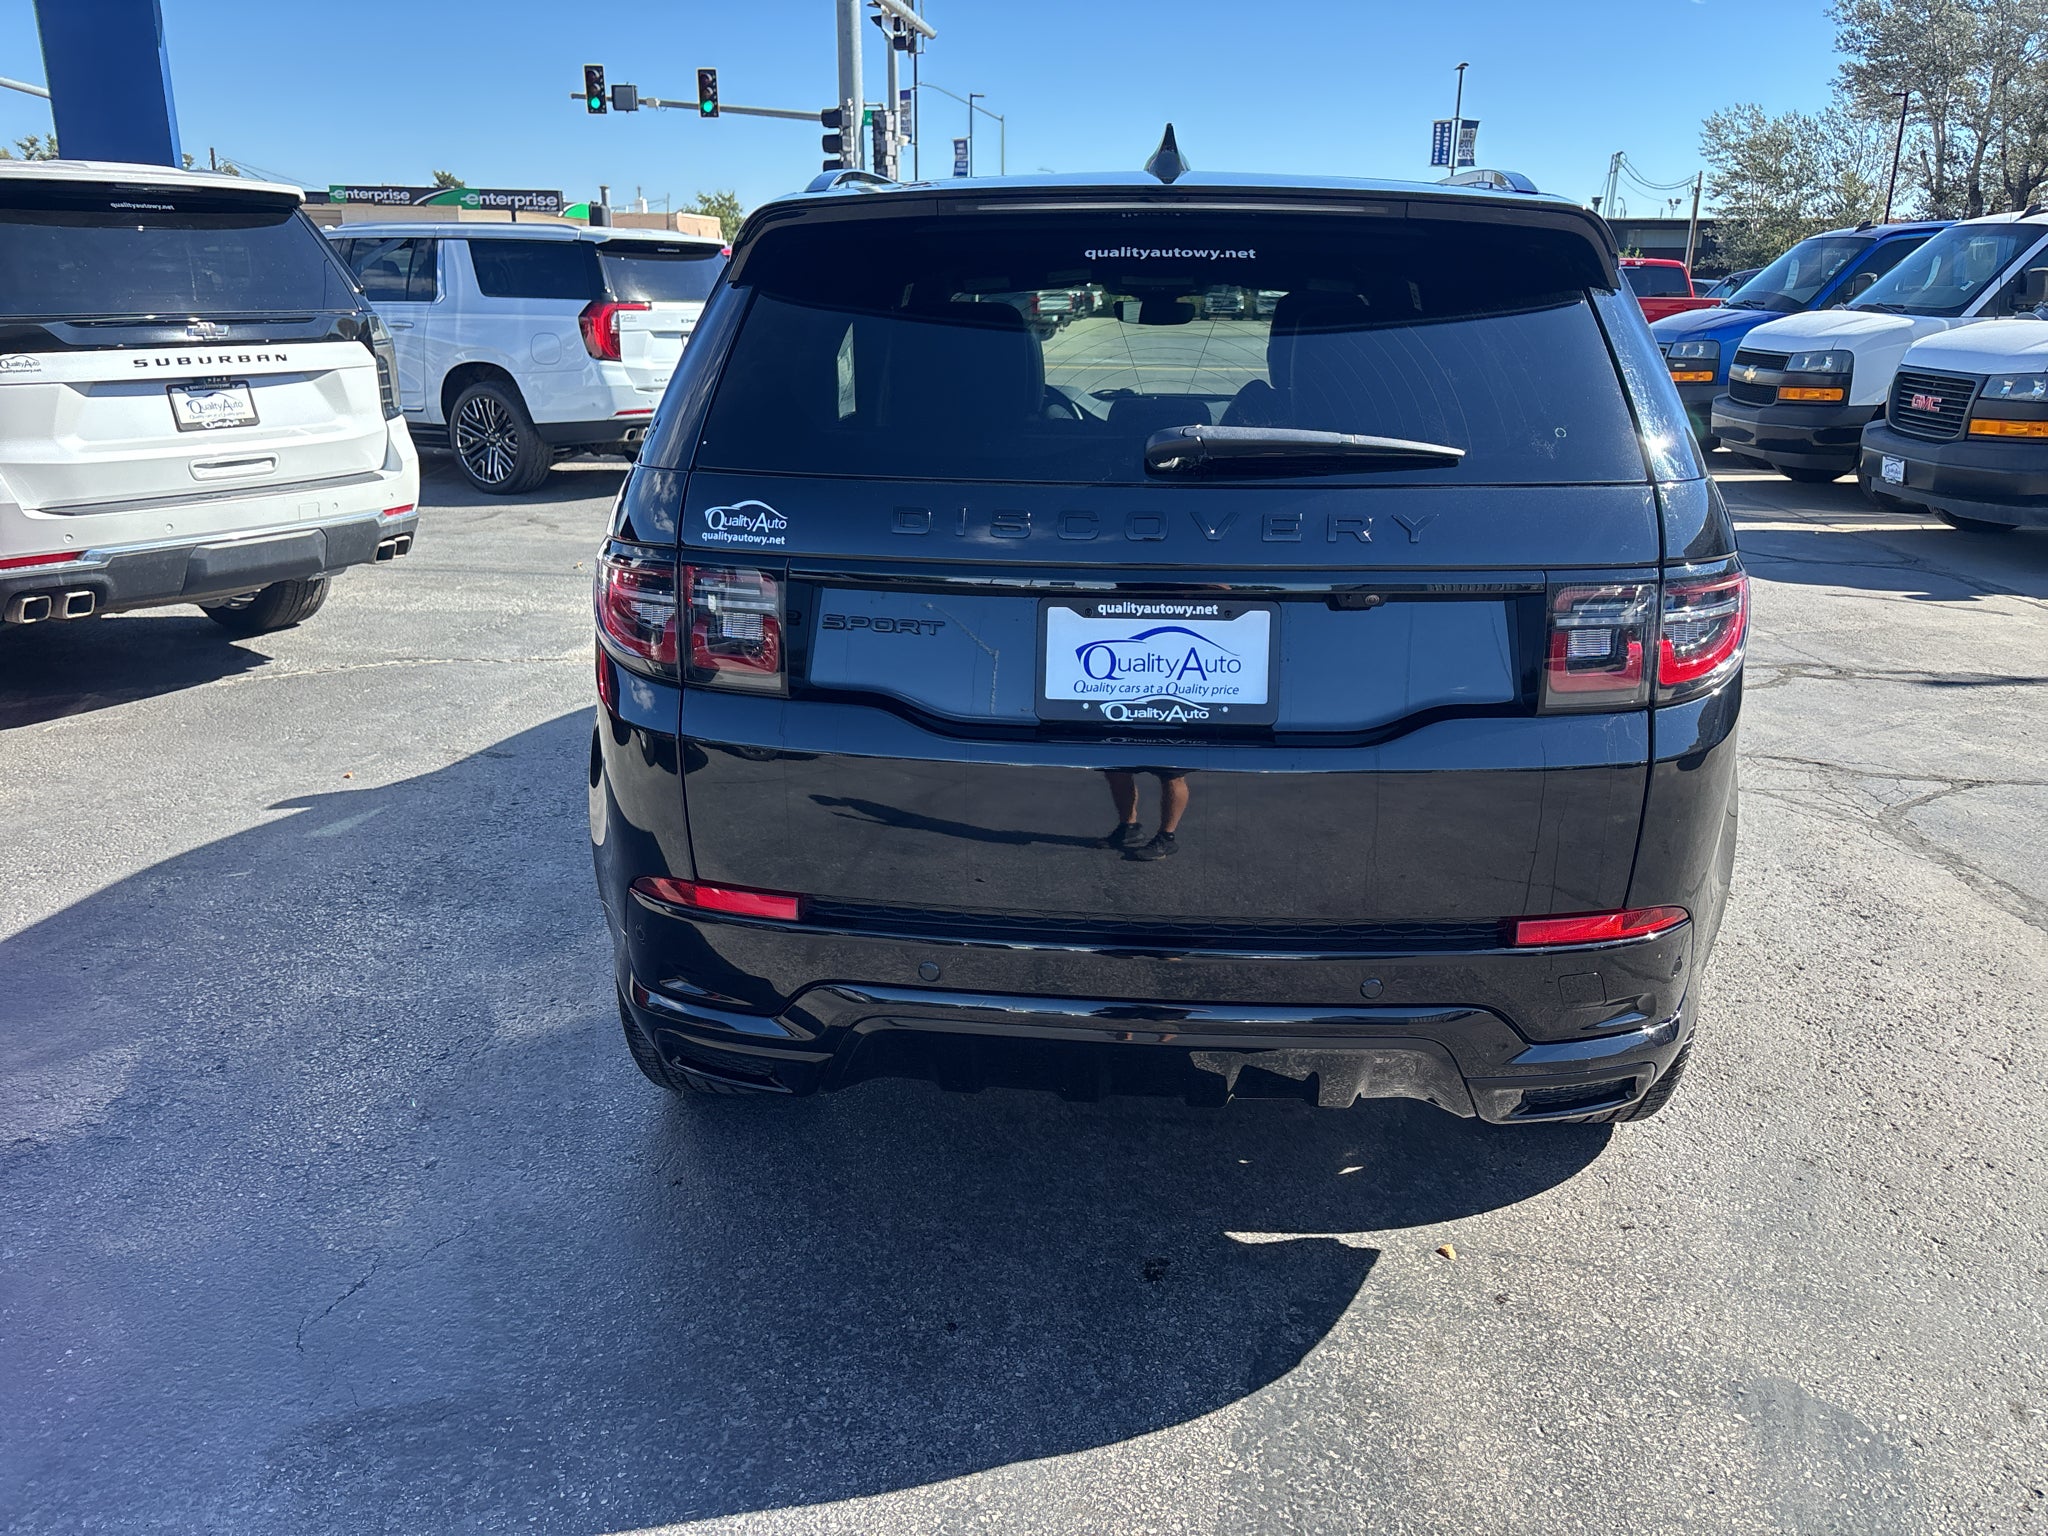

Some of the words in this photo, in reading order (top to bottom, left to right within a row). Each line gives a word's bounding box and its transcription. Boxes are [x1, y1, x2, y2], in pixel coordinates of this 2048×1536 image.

[1462, 130, 1474, 138] WE
[1459, 139, 1474, 148] BUY
[332, 188, 410, 202] enterprise
[463, 192, 558, 208] enterprise
[1084, 246, 1256, 260] qualityautowy.net
[133, 352, 288, 369] SUBURBAN
[1911, 394, 1942, 412] GMC
[890, 505, 1440, 544] DISCOVERY
[701, 530, 786, 545] qualityautowy.net
[1098, 602, 1218, 617] qualityautowy.net
[822, 613, 946, 636] SPORT
[1074, 680, 1117, 694] Quality
[1118, 684, 1140, 694] cars
[1143, 684, 1154, 694] at
[1156, 686, 1164, 694] a
[1166, 681, 1210, 696] Quality
[1211, 684, 1240, 697] price
